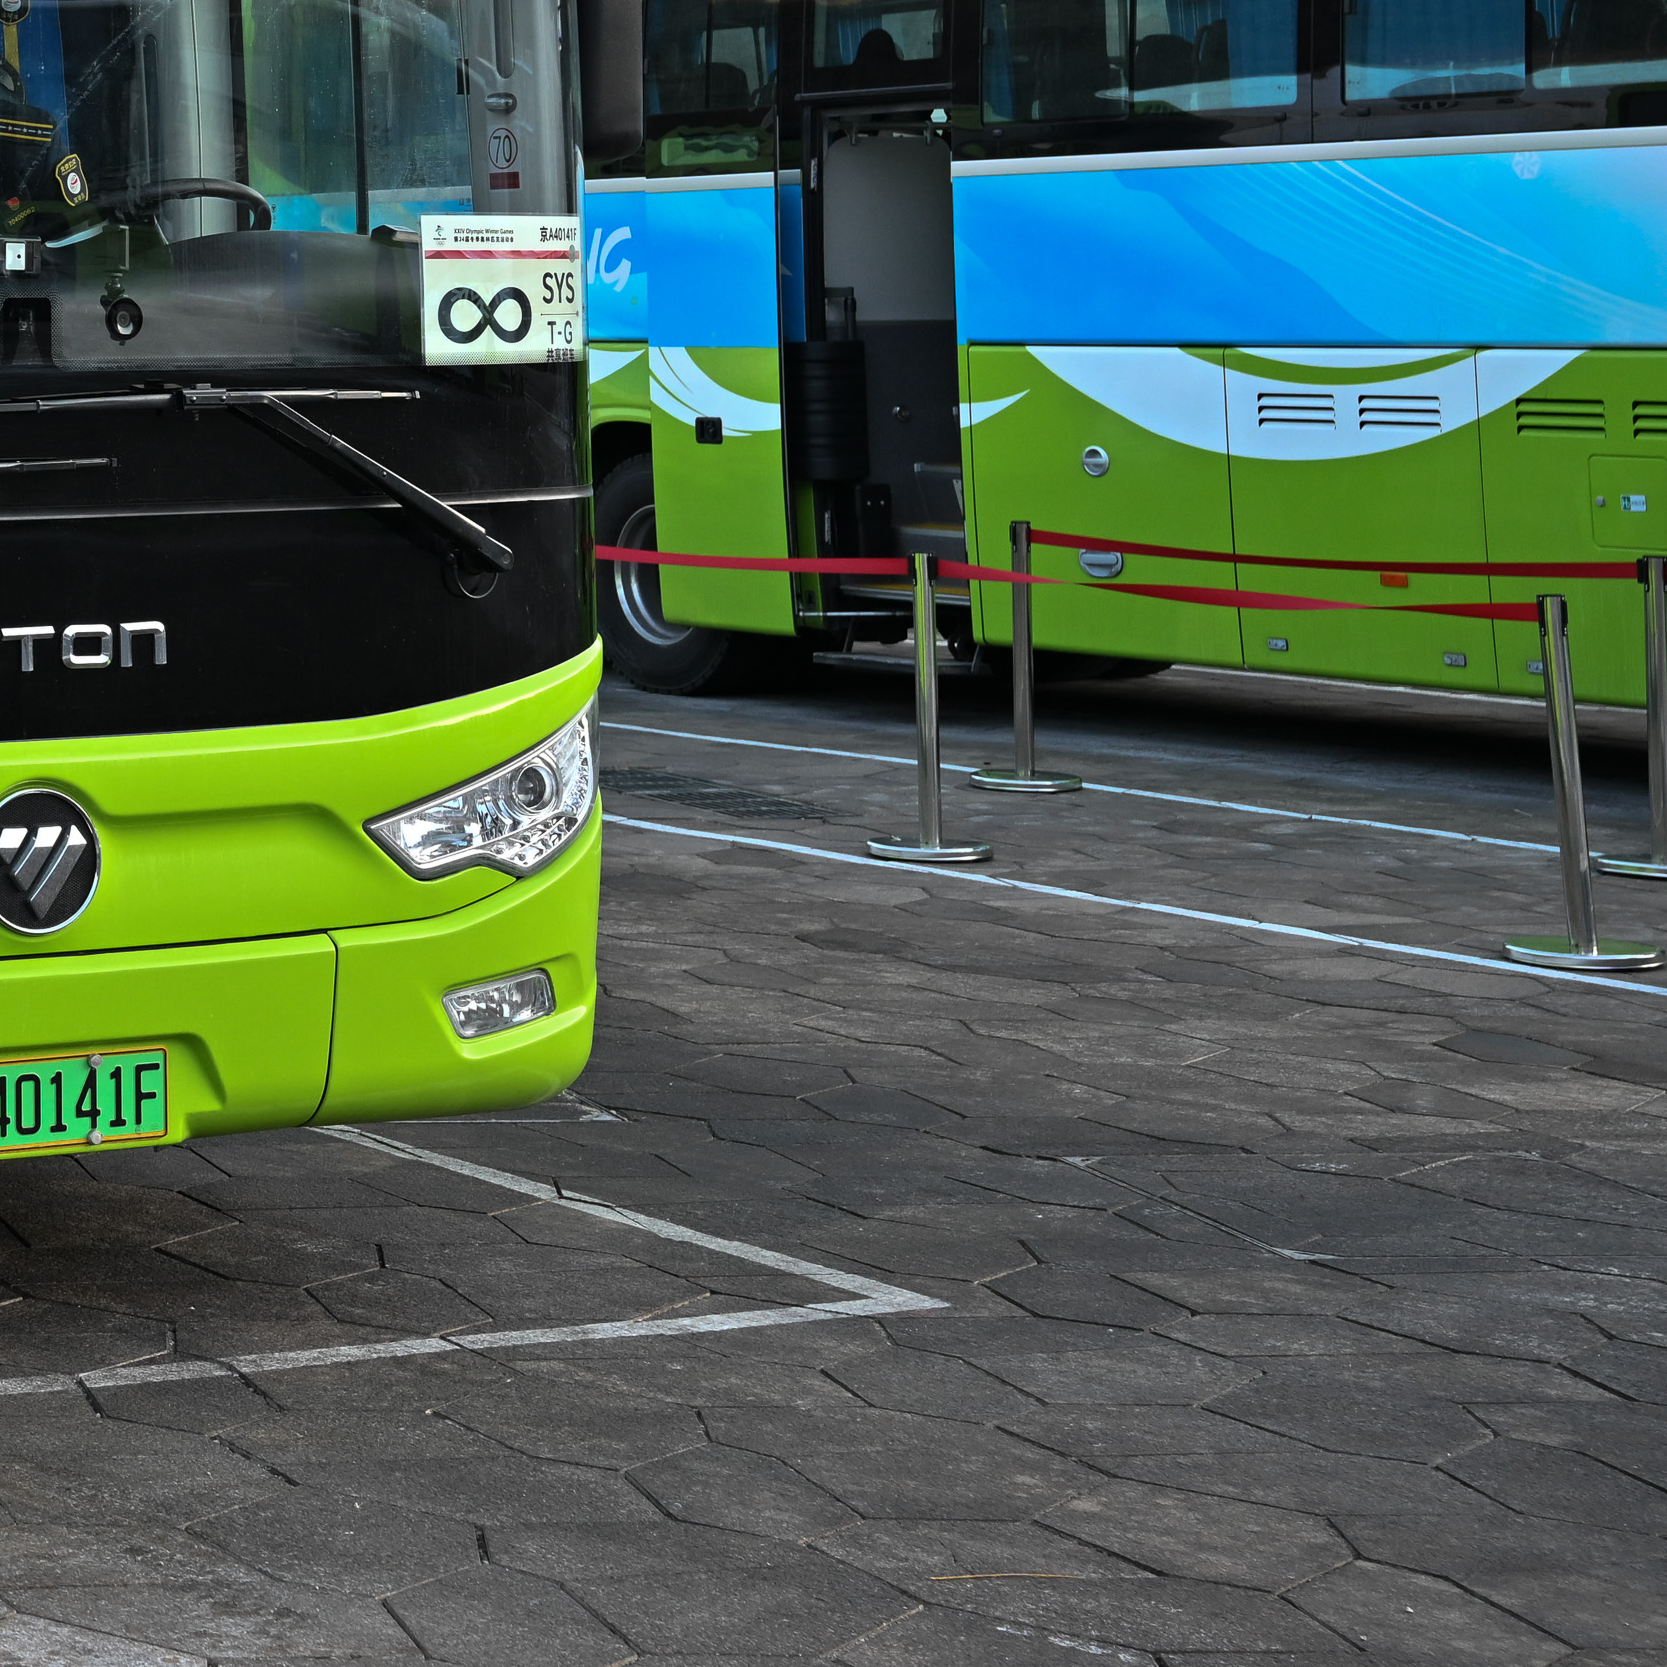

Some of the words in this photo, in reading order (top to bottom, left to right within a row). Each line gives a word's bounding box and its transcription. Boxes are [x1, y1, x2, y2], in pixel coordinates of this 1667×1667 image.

[492, 135, 513, 163] 70
[466, 228, 484, 236] Olympic
[540, 226, 577, 242] 京A40141F
[542, 272, 575, 304] SYS
[547, 320, 573, 345] T-G
